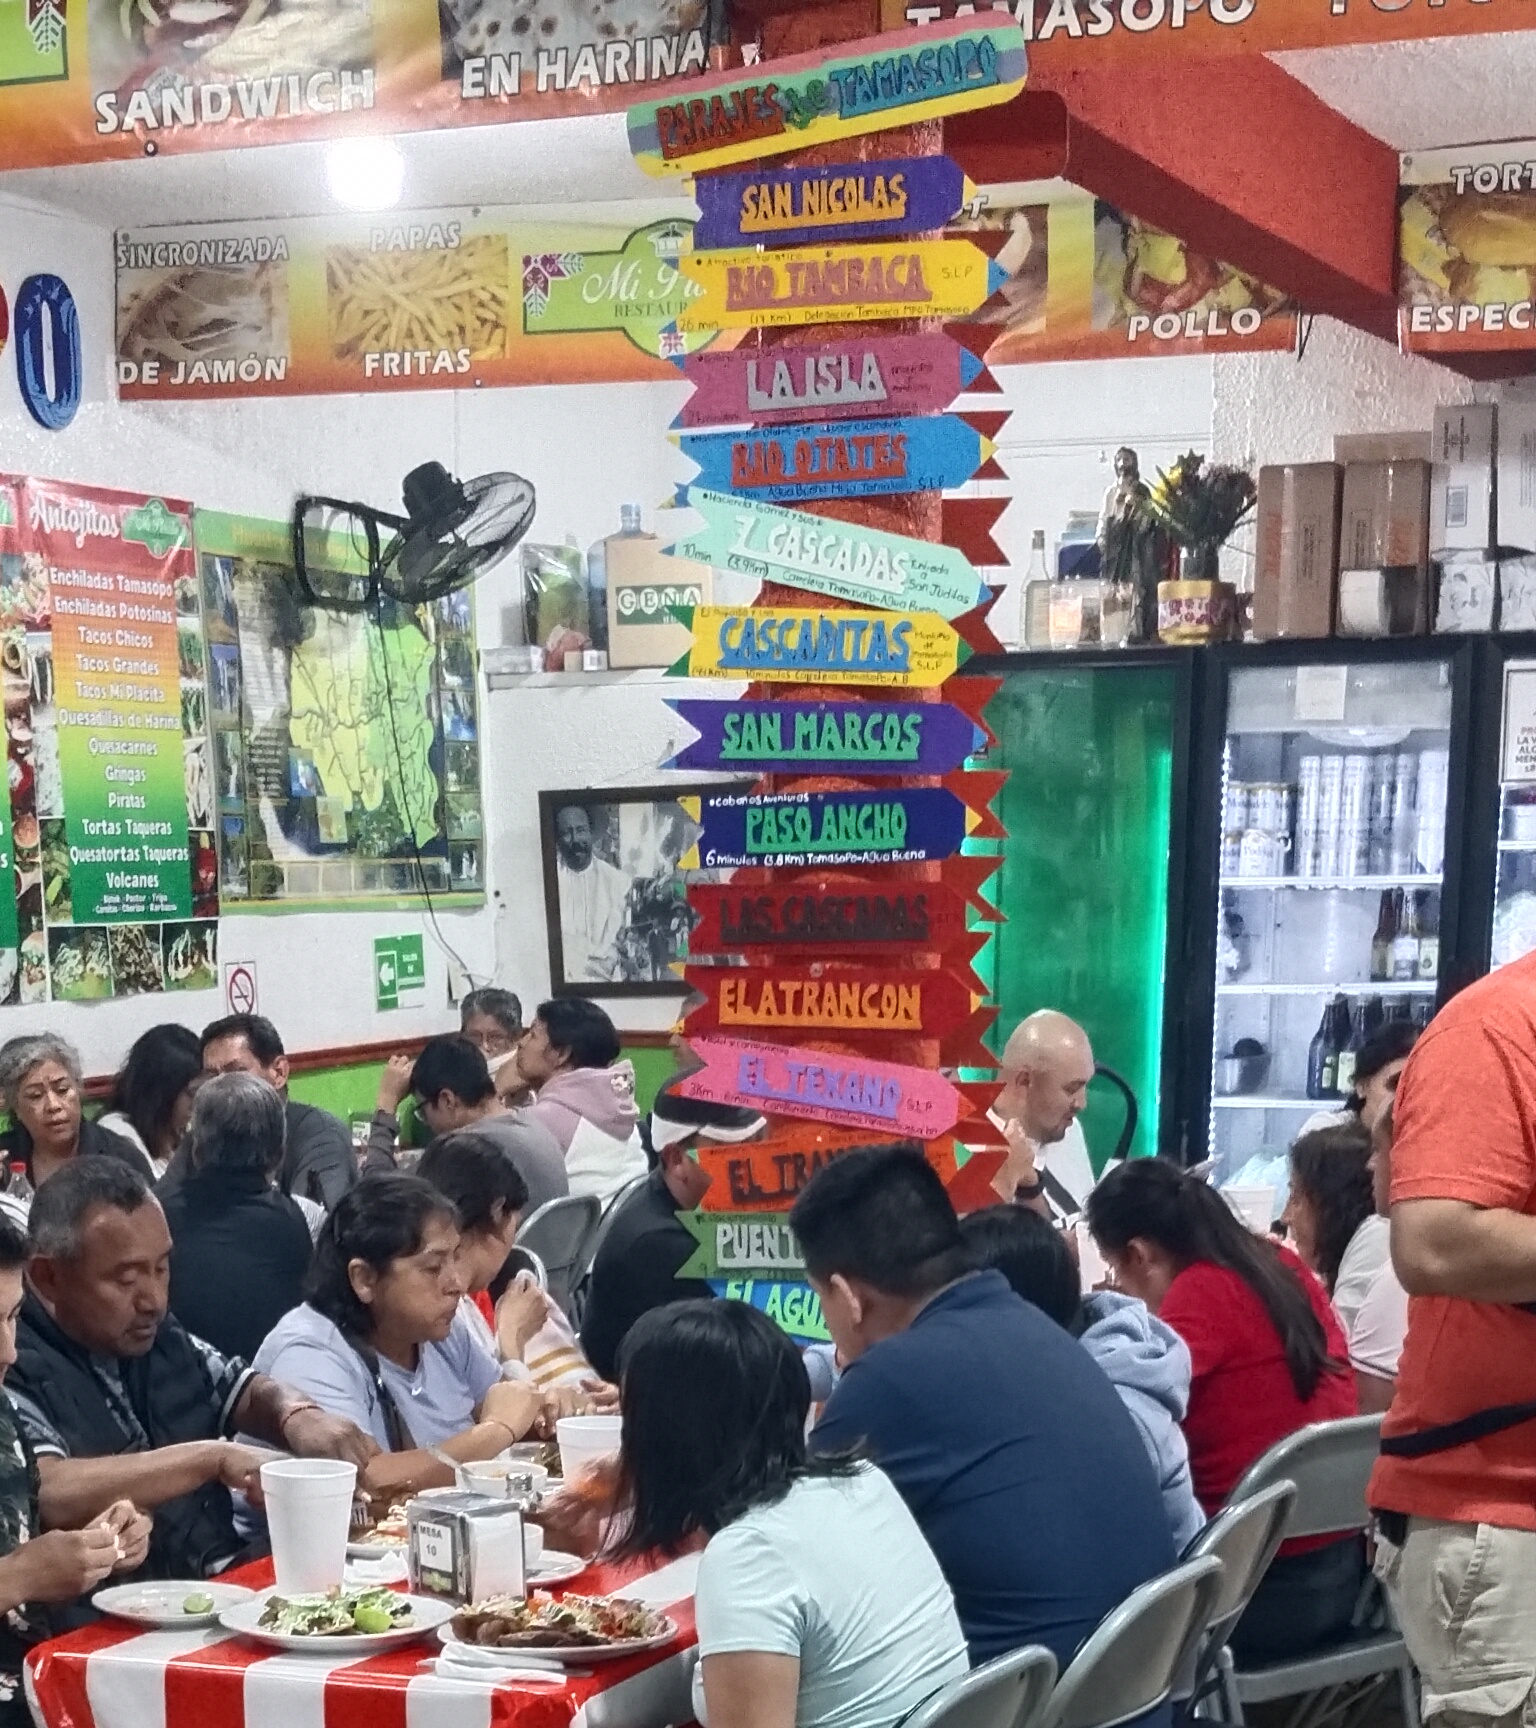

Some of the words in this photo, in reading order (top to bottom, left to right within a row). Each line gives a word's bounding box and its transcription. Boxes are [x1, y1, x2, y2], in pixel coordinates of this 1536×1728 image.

[461, 55, 524, 98] EN
[538, 30, 710, 92] HARINA
[95, 68, 376, 134] SANDWICH
[740, 180, 792, 228] SAN
[799, 173, 908, 222] NICOLAS
[115, 233, 290, 268] SINCRONIZADA
[370, 222, 462, 252] PAPAS
[1126, 309, 1263, 343] POLLO
[118, 360, 161, 386] DE
[170, 352, 288, 384] JAMÓN
[364, 349, 472, 378] FRITAS
[747, 357, 795, 408] LA
[794, 352, 887, 404] ISLA
[30, 491, 121, 549] Antojitos
[768, 523, 911, 592] CASCADAS
[49, 567, 115, 591] Enchiladas
[117, 575, 173, 599] Tamasopo
[54, 596, 117, 619] Enchiladas
[119, 603, 173, 623] Potosinas
[617, 586, 702, 613] GENA
[78, 626, 113, 645] Tacos
[116, 630, 154, 648] Chicos
[76, 653, 110, 672] Tacos
[112, 657, 160, 676] Grandes
[722, 712, 782, 758] SAN
[795, 711, 924, 757] MARCOS
[105, 765, 146, 786] Gringas
[108, 792, 146, 809] Piratas
[82, 819, 122, 836] Tortas
[125, 819, 173, 839] Taqueras
[746, 806, 812, 852] PASO
[821, 802, 908, 848] ANCHO
[69, 845, 141, 866] Quesatortas
[142, 845, 190, 866] Taqueras
[705, 849, 716, 867] 6
[105, 871, 159, 889] Volcanes
[419, 1524, 444, 1540] MESA
[426, 1544, 437, 1557] 10
